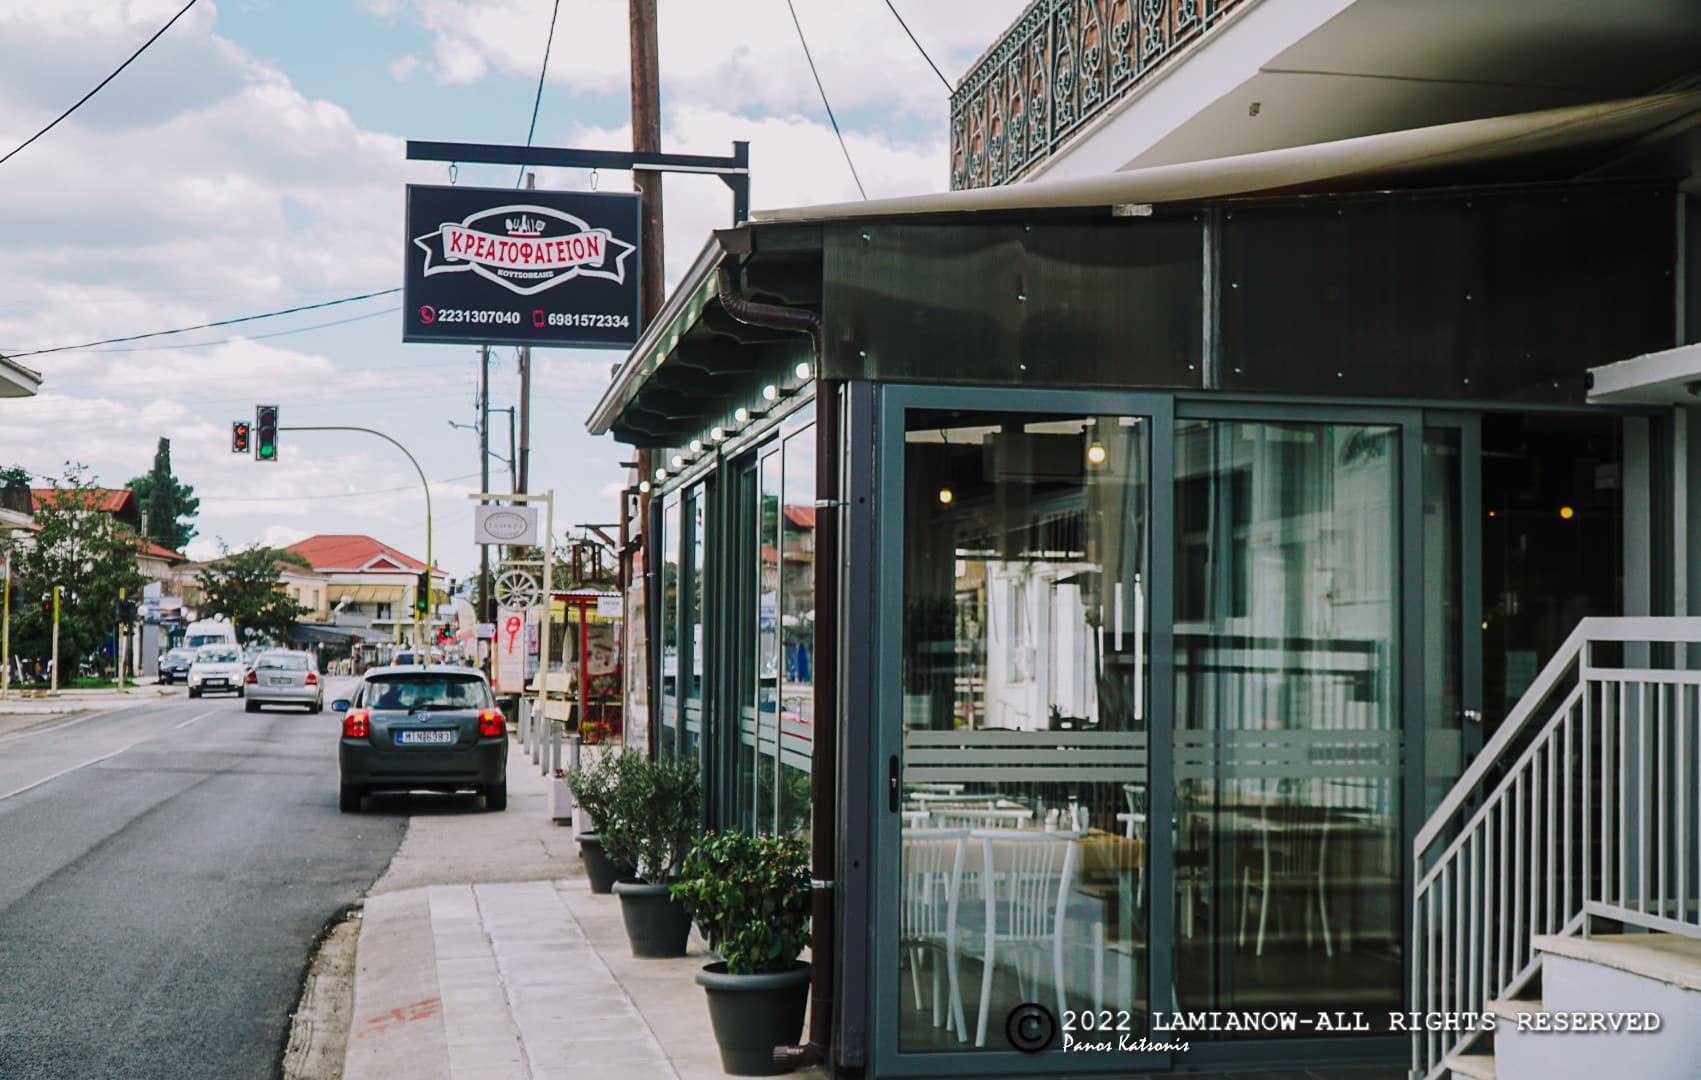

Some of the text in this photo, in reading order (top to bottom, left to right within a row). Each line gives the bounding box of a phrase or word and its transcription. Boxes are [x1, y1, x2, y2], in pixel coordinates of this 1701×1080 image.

[449, 231, 600, 265] ΚΡΕΑΤΟΦΑΓΕΙΟΝ
[438, 309, 629, 329] 2231307040 6981572334
